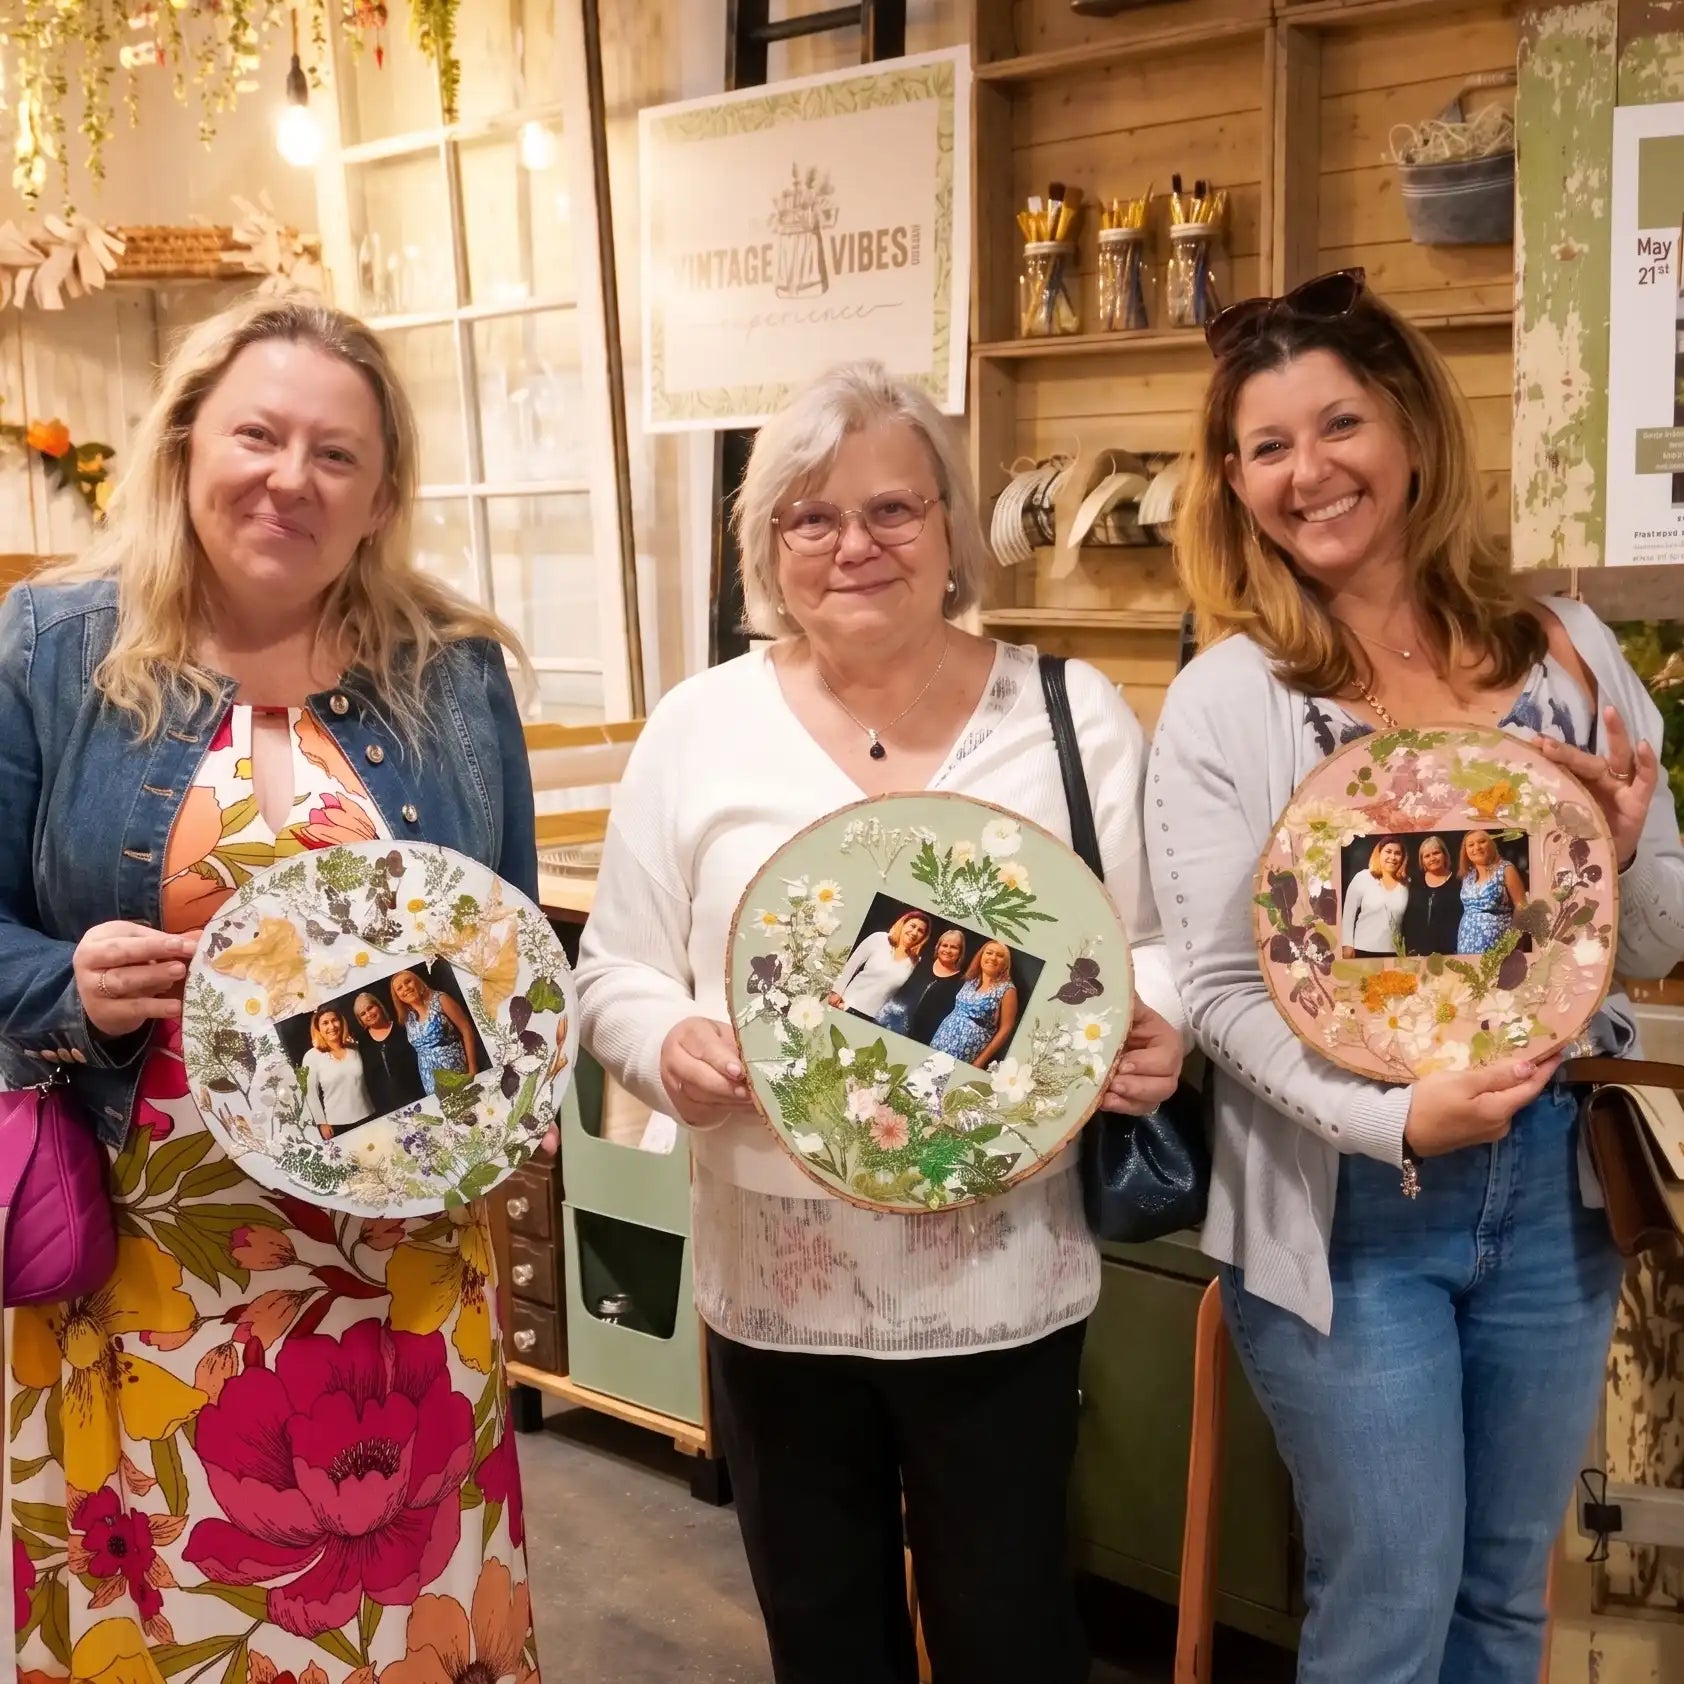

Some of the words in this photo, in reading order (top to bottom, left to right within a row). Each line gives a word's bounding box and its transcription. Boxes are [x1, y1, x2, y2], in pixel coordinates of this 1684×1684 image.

[670, 242, 774, 291] VINTAGE
[830, 225, 908, 275] VIBES
[1637, 236, 1672, 263] May
[1638, 263, 1670, 285] 21st
[690, 299, 905, 343] perience
